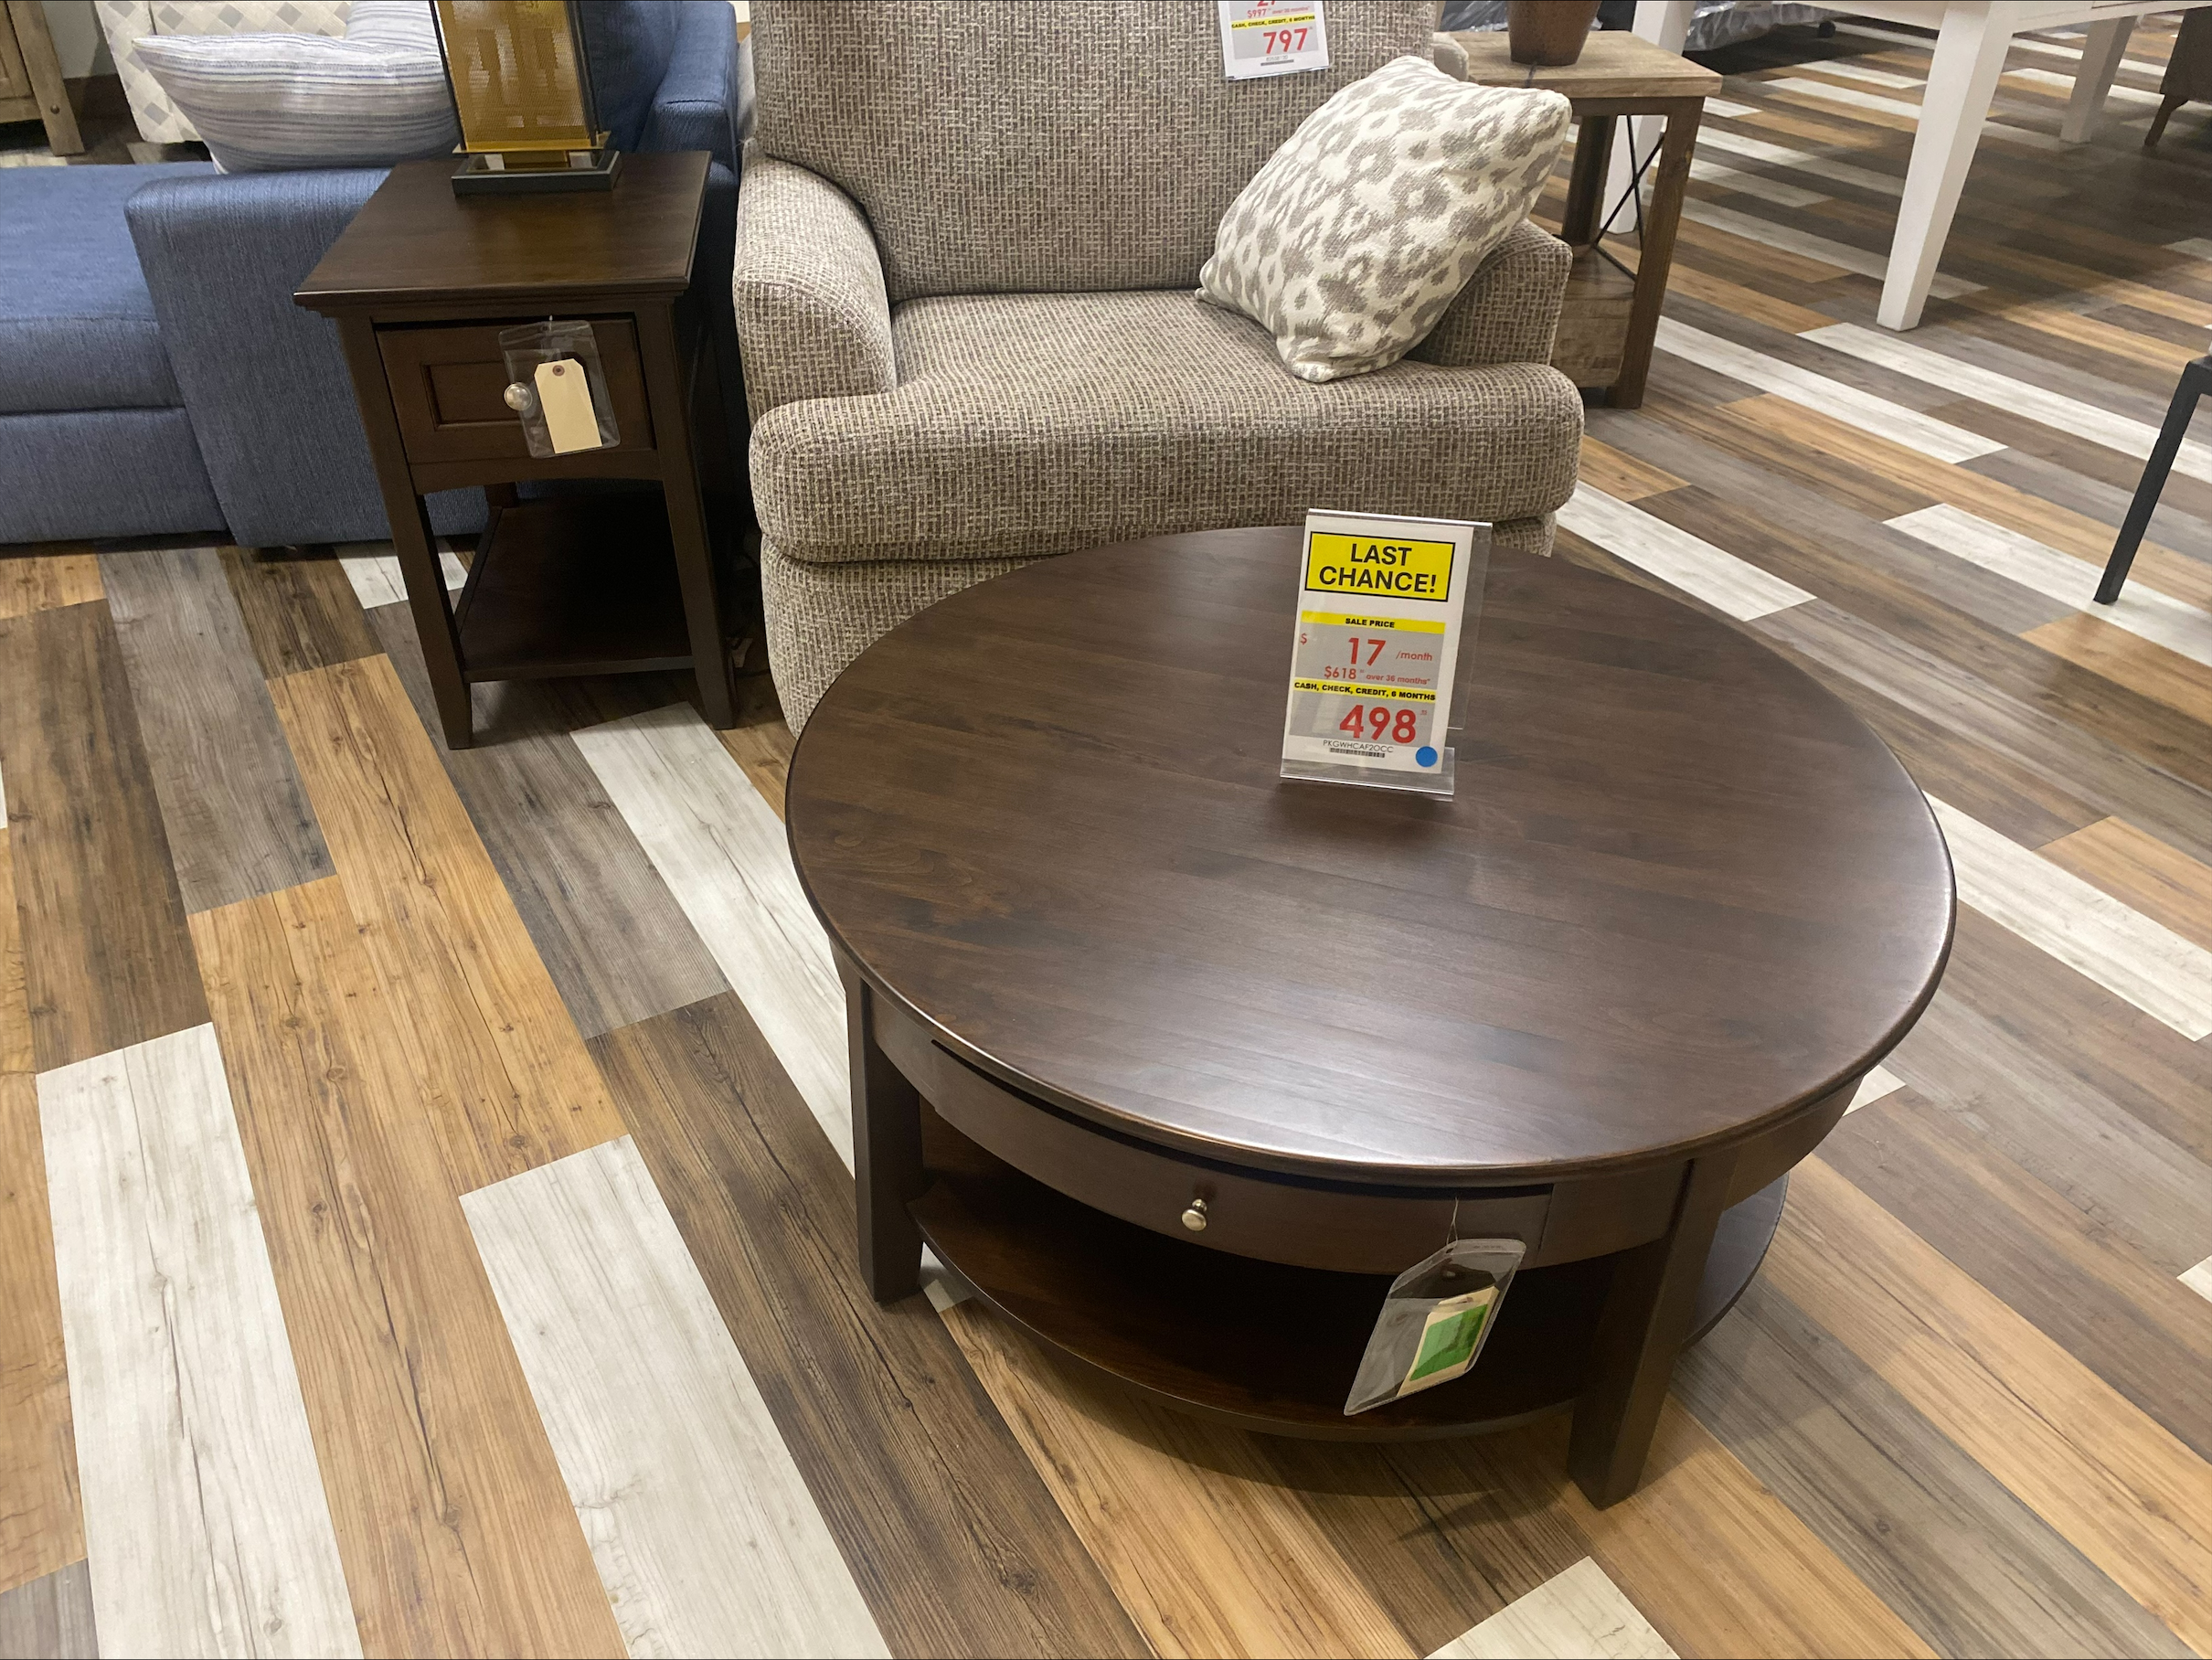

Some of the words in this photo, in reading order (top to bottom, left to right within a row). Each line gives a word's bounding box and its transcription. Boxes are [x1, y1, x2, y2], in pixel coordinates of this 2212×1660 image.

[1263, 27, 1308, 54] 797
[1351, 543, 1412, 566] LAST
[1319, 566, 1436, 593] CHANCE!
[1345, 618, 1367, 626] SALE
[1369, 620, 1395, 628] PRICE
[1300, 633, 1308, 645] $
[1348, 637, 1387, 666] 17
[1396, 651, 1432, 662] /month
[1324, 665, 1356, 679] $618
[1294, 682, 1319, 691] CASH,
[1322, 685, 1353, 695] CHECK,
[1356, 687, 1388, 697] CREDIT,
[1398, 692, 1436, 701] MONTHS
[1339, 704, 1416, 744] 498
